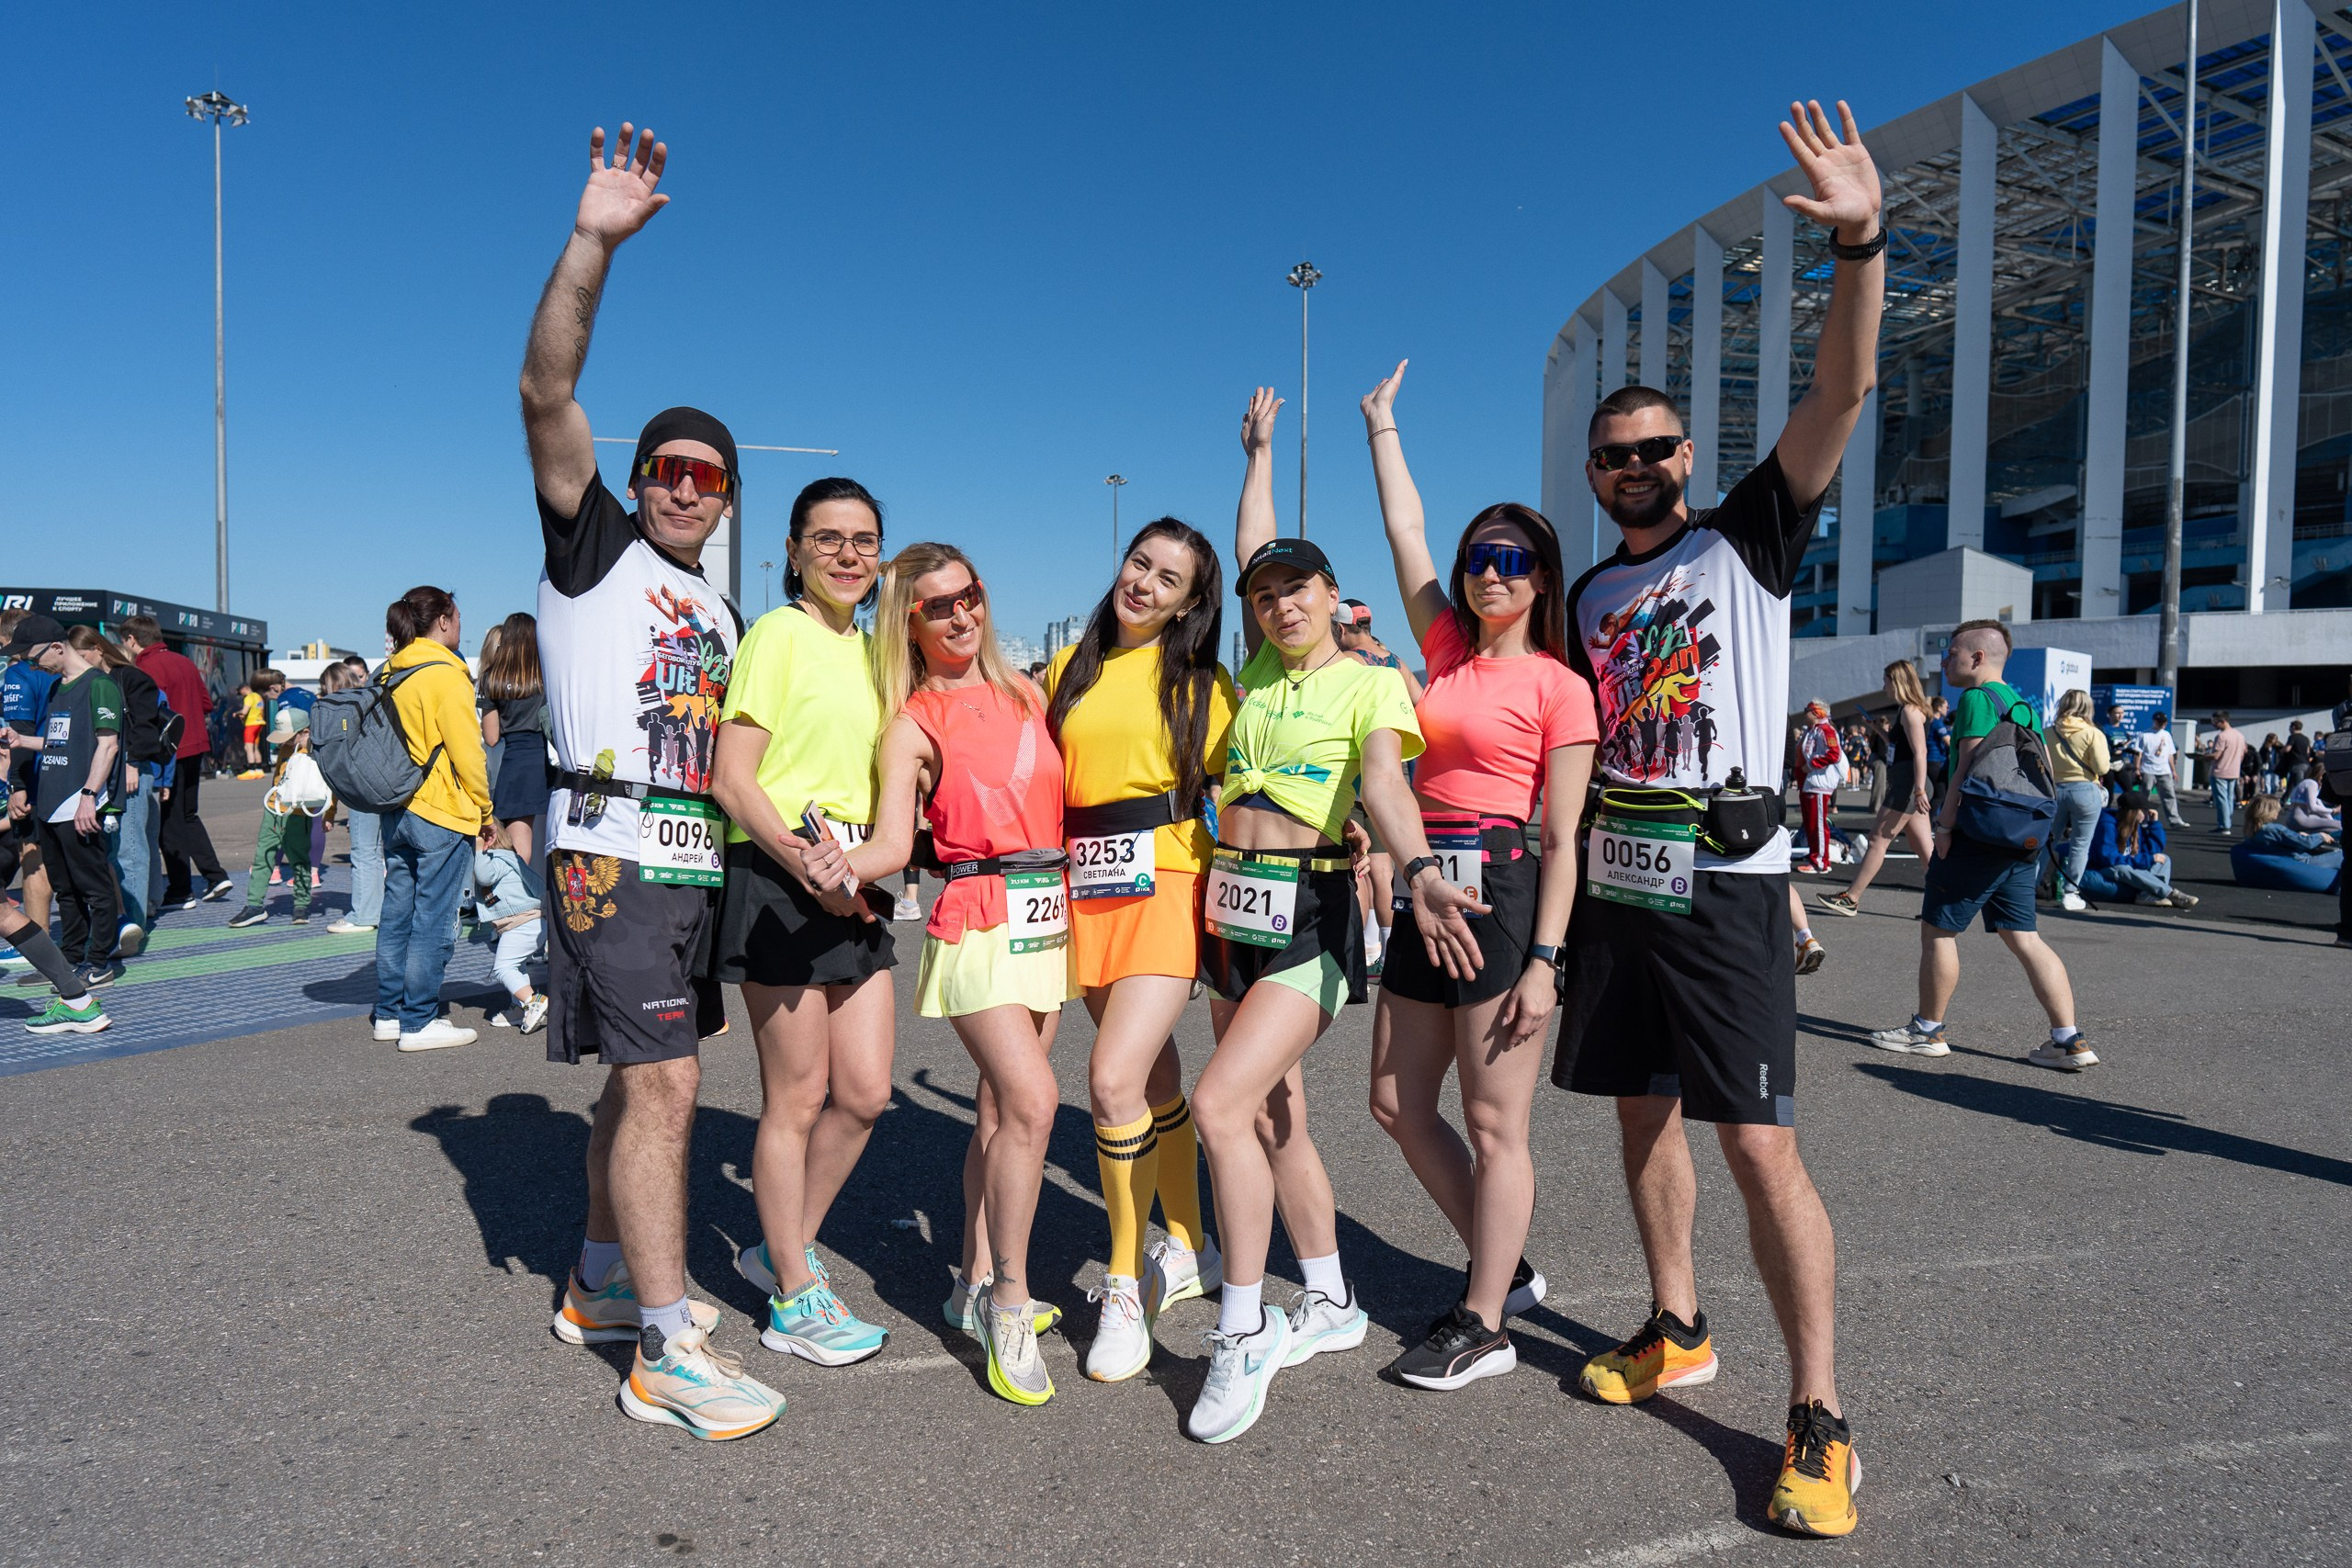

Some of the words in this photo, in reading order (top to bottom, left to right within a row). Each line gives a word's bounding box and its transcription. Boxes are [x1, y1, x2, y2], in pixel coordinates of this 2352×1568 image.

[0, 595, 33, 610] RI
[113, 600, 137, 616] PARI
[178, 612, 198, 627] PARI
[232, 622, 247, 635] PARI
[1627, 661, 1645, 675] КЛУБ
[659, 819, 713, 851] 0096
[672, 852, 703, 863] АНДРЕЙ
[1076, 838, 1135, 867] 3253
[1602, 837, 1671, 874] 0056
[1084, 869, 1125, 879] СВЕТЛАНА
[1607, 870, 1665, 888] АЛЕКСАНДР
[1216, 881, 1272, 917] 2021
[1026, 893, 1065, 924] 2269
[642, 998, 690, 1010] NATIONAL
[656, 1010, 685, 1021] TEAM
[1758, 1063, 1770, 1100] Reebok
